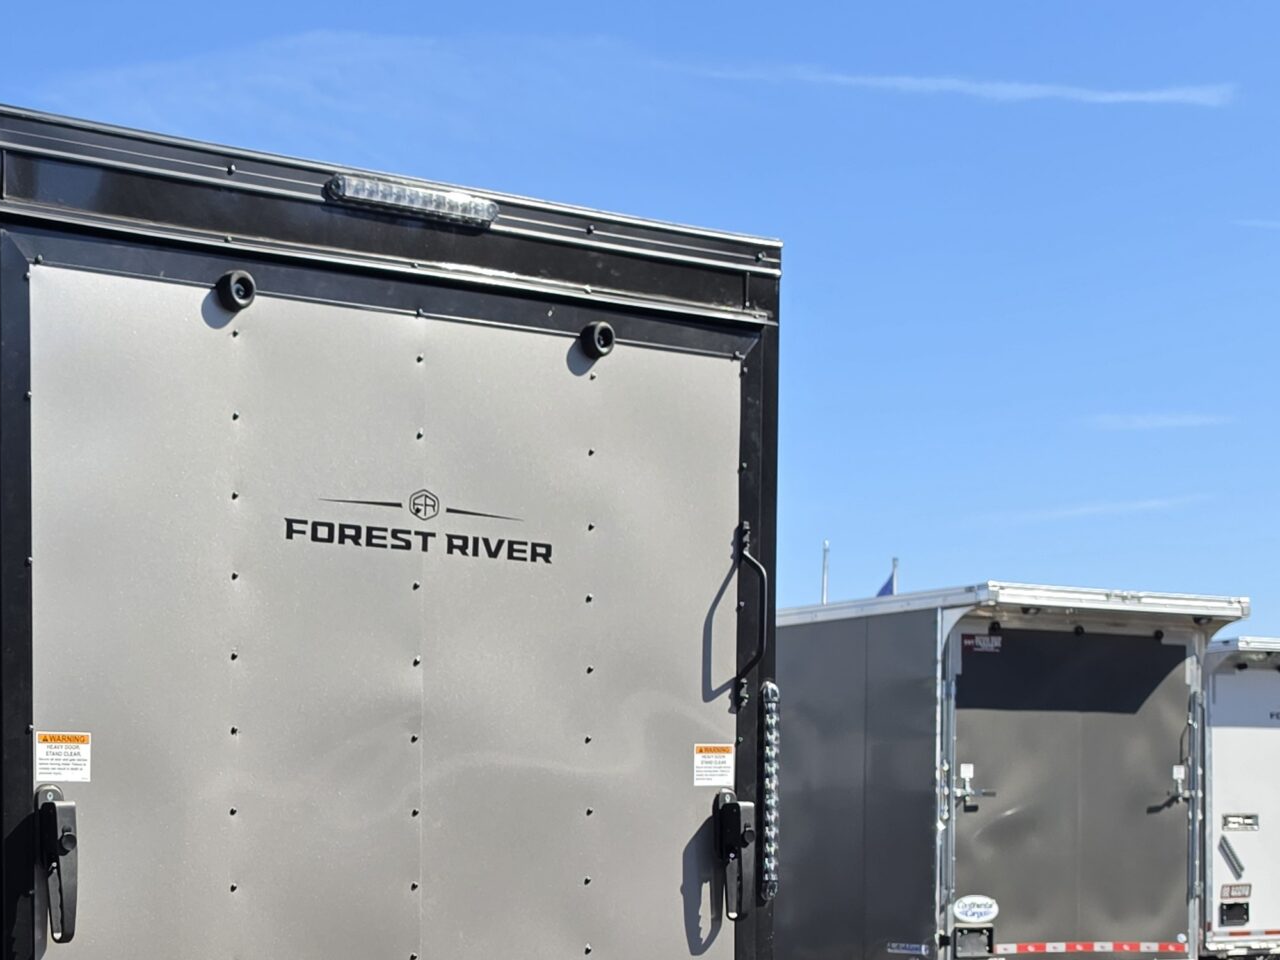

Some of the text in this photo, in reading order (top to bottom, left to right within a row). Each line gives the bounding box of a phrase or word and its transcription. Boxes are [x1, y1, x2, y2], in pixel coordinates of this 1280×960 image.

[284, 518, 552, 564] FOREST RIVER
[50, 735, 85, 743] WARNING
